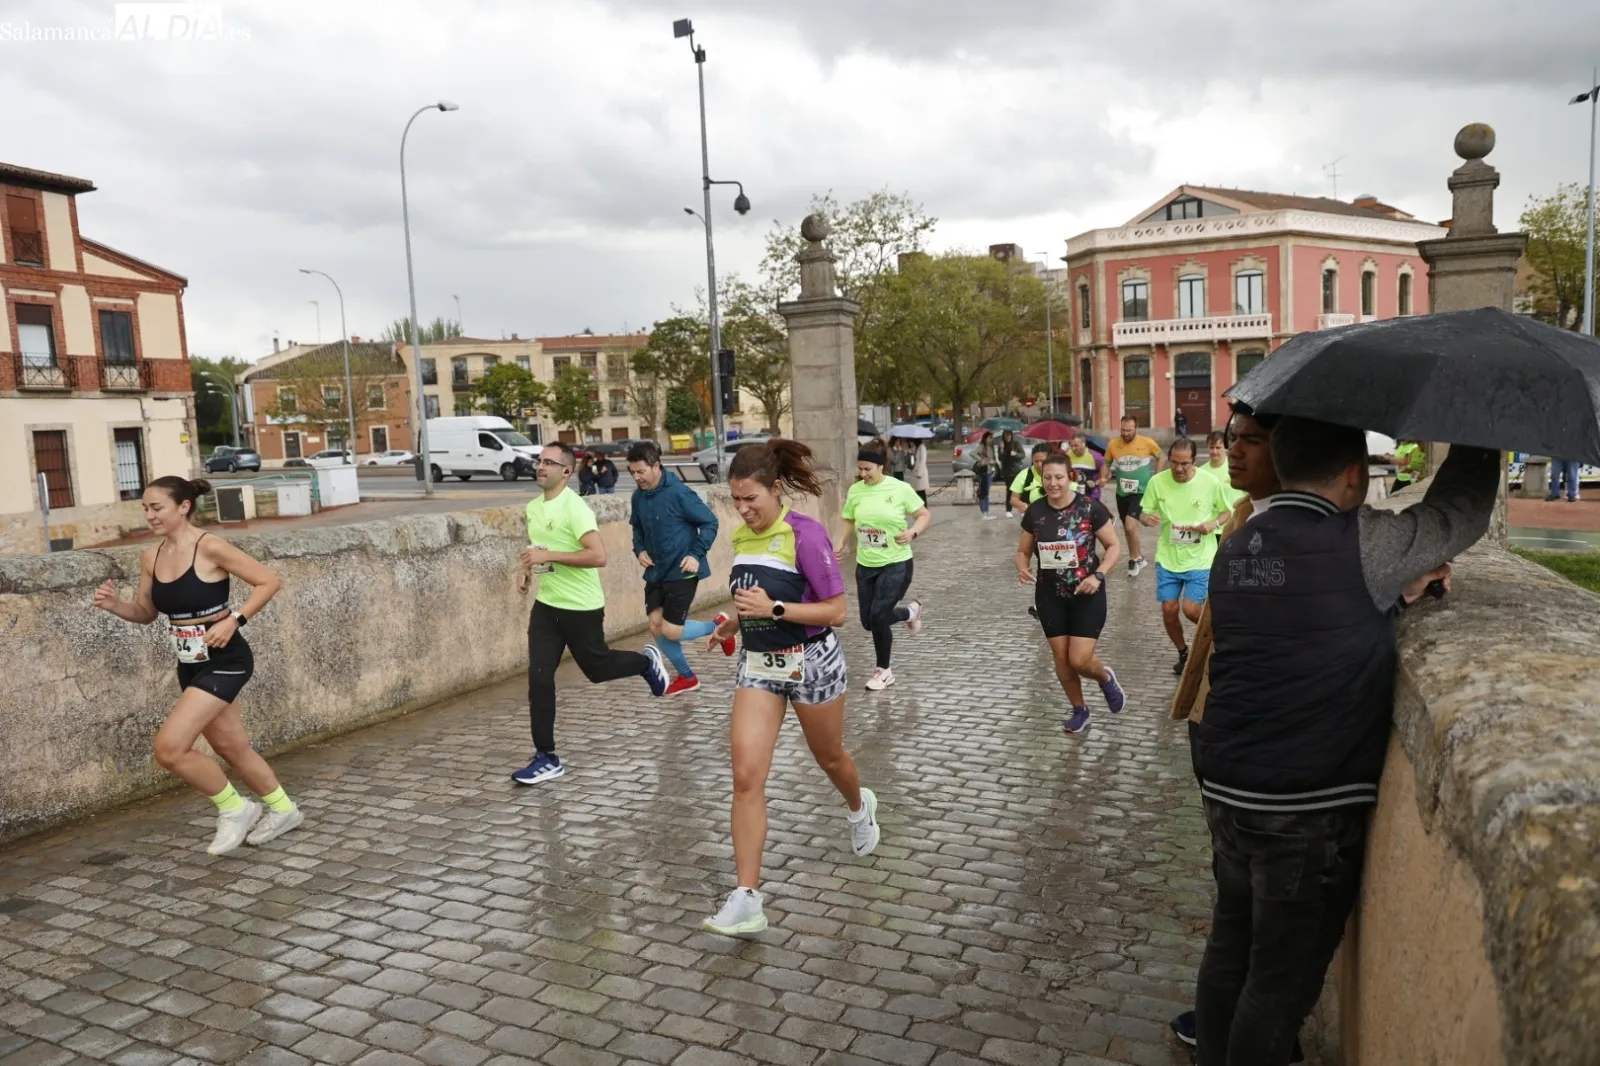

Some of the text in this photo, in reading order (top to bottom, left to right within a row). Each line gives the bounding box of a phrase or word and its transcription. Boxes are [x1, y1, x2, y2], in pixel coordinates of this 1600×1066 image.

[867, 534, 879, 543] 12
[1179, 530, 1192, 539] 71
[1054, 550, 1062, 561] 4
[763, 652, 786, 668] 35
